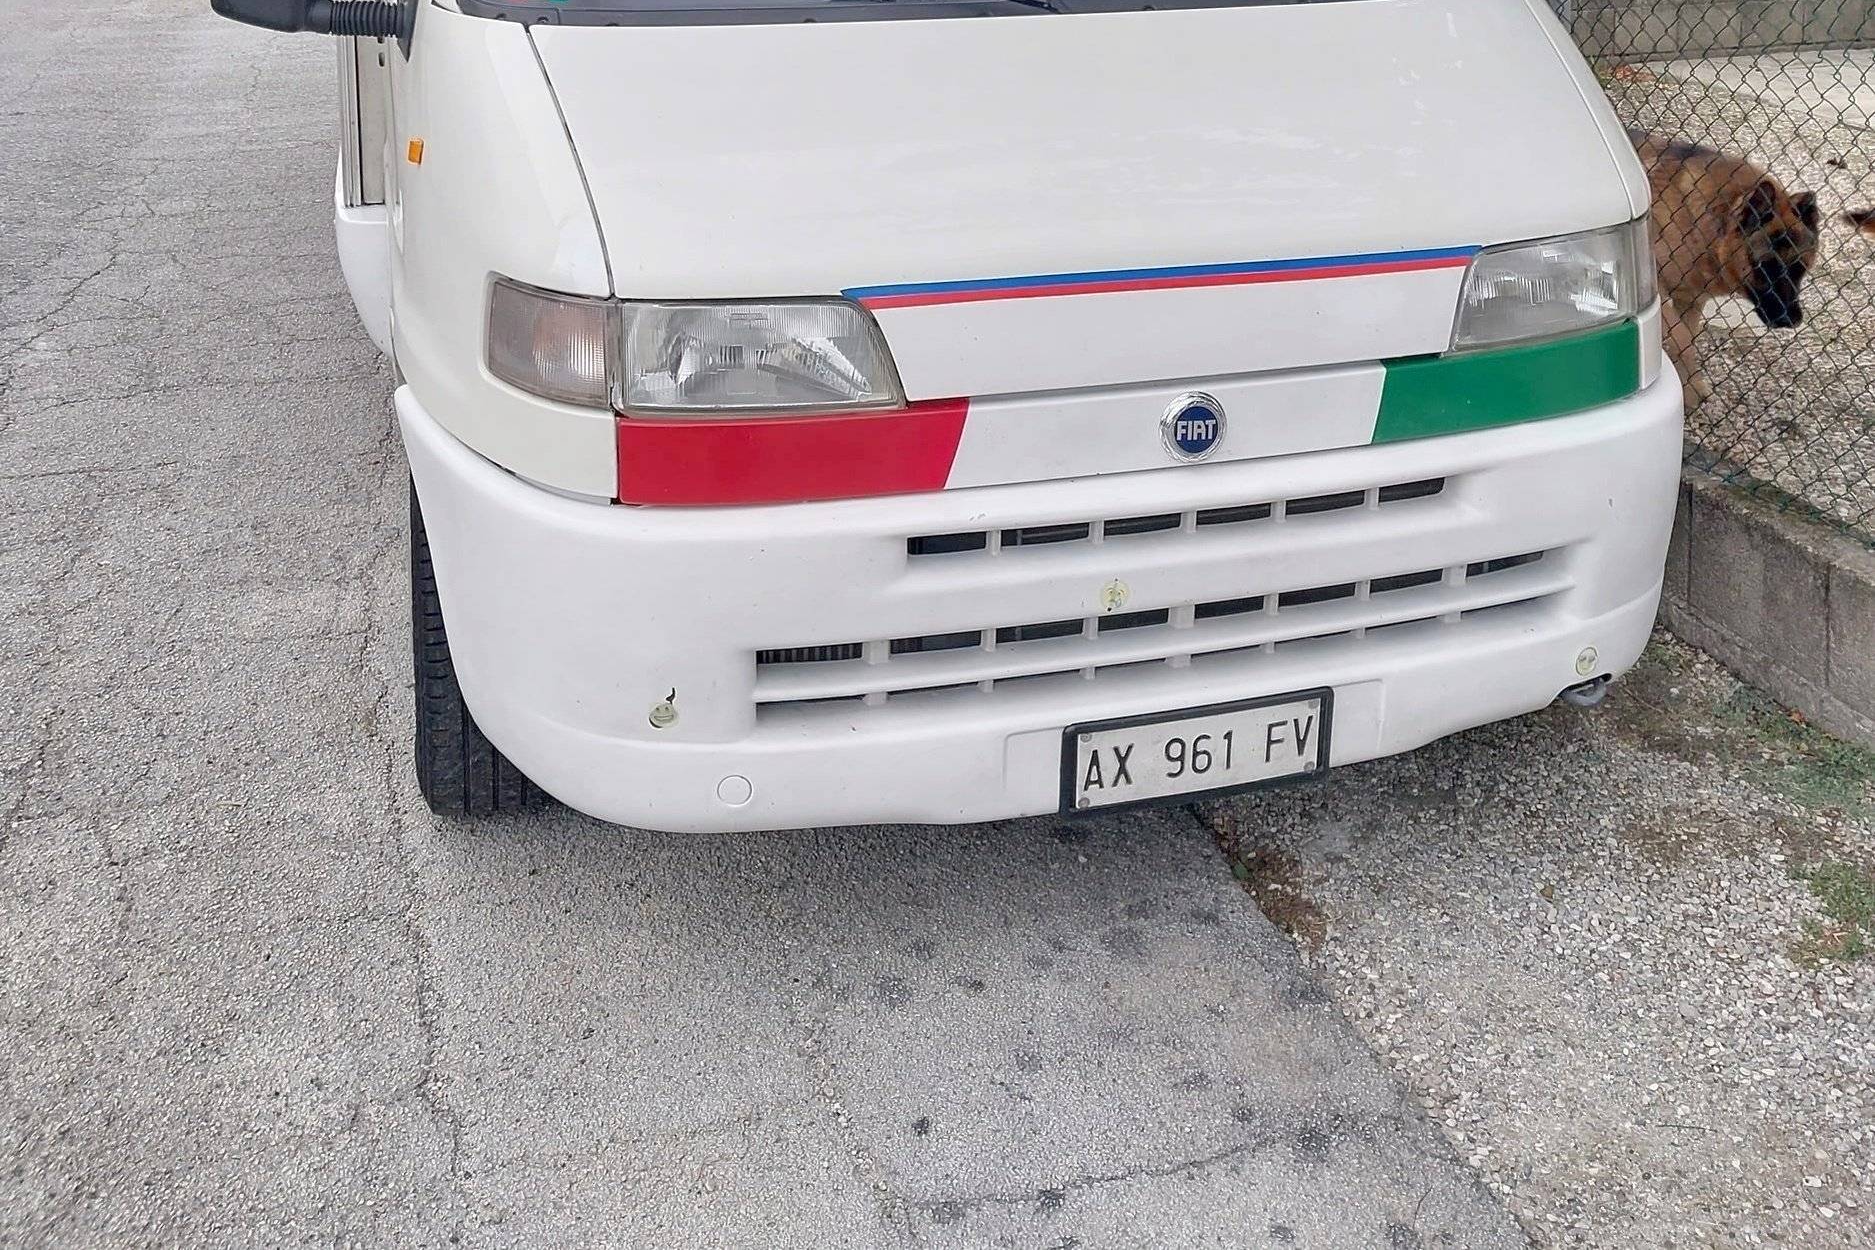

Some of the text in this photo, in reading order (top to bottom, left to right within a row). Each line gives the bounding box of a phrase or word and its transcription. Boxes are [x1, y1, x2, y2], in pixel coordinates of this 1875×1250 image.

[1176, 419, 1216, 441] FIAT
[1083, 714, 1314, 792] AX 961 FV
